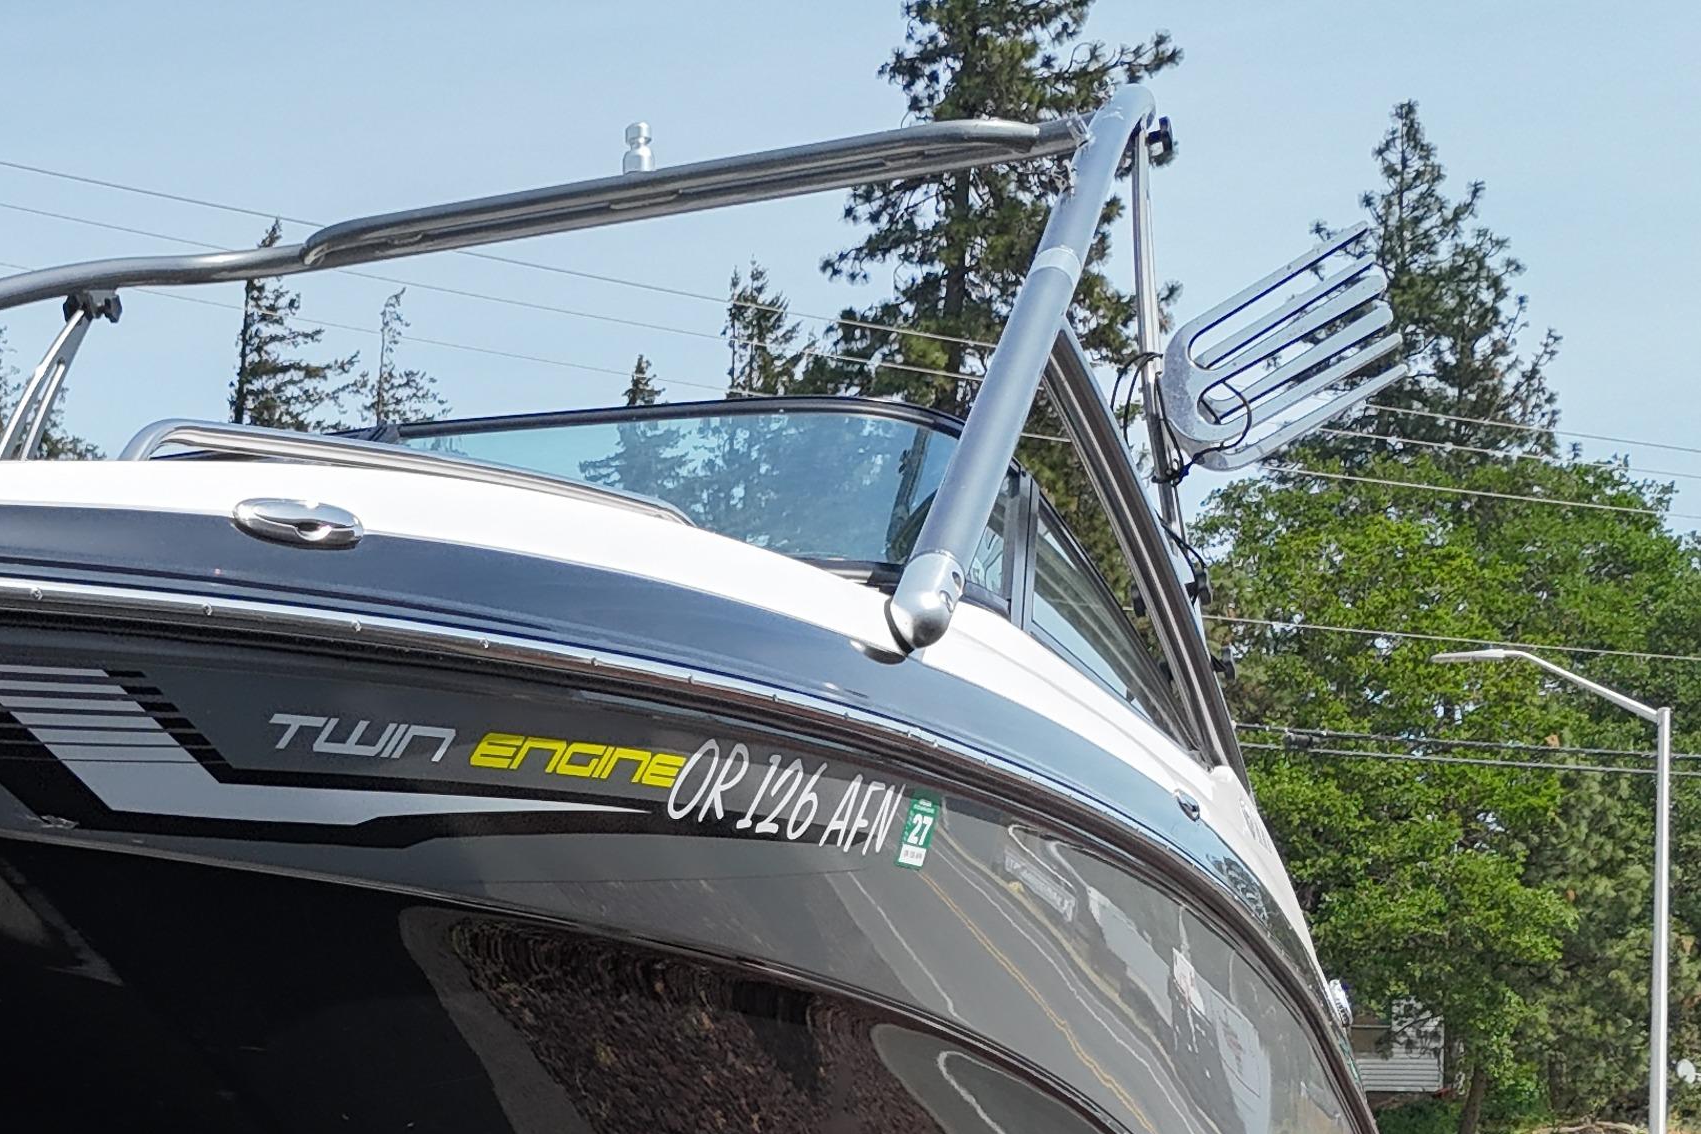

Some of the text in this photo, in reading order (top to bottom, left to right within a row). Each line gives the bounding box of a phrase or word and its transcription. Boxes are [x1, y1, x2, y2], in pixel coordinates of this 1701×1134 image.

[269, 713, 687, 788] TWIN ENGINE
[667, 738, 907, 856] OR 126 AFN
[906, 813, 934, 846] 27
